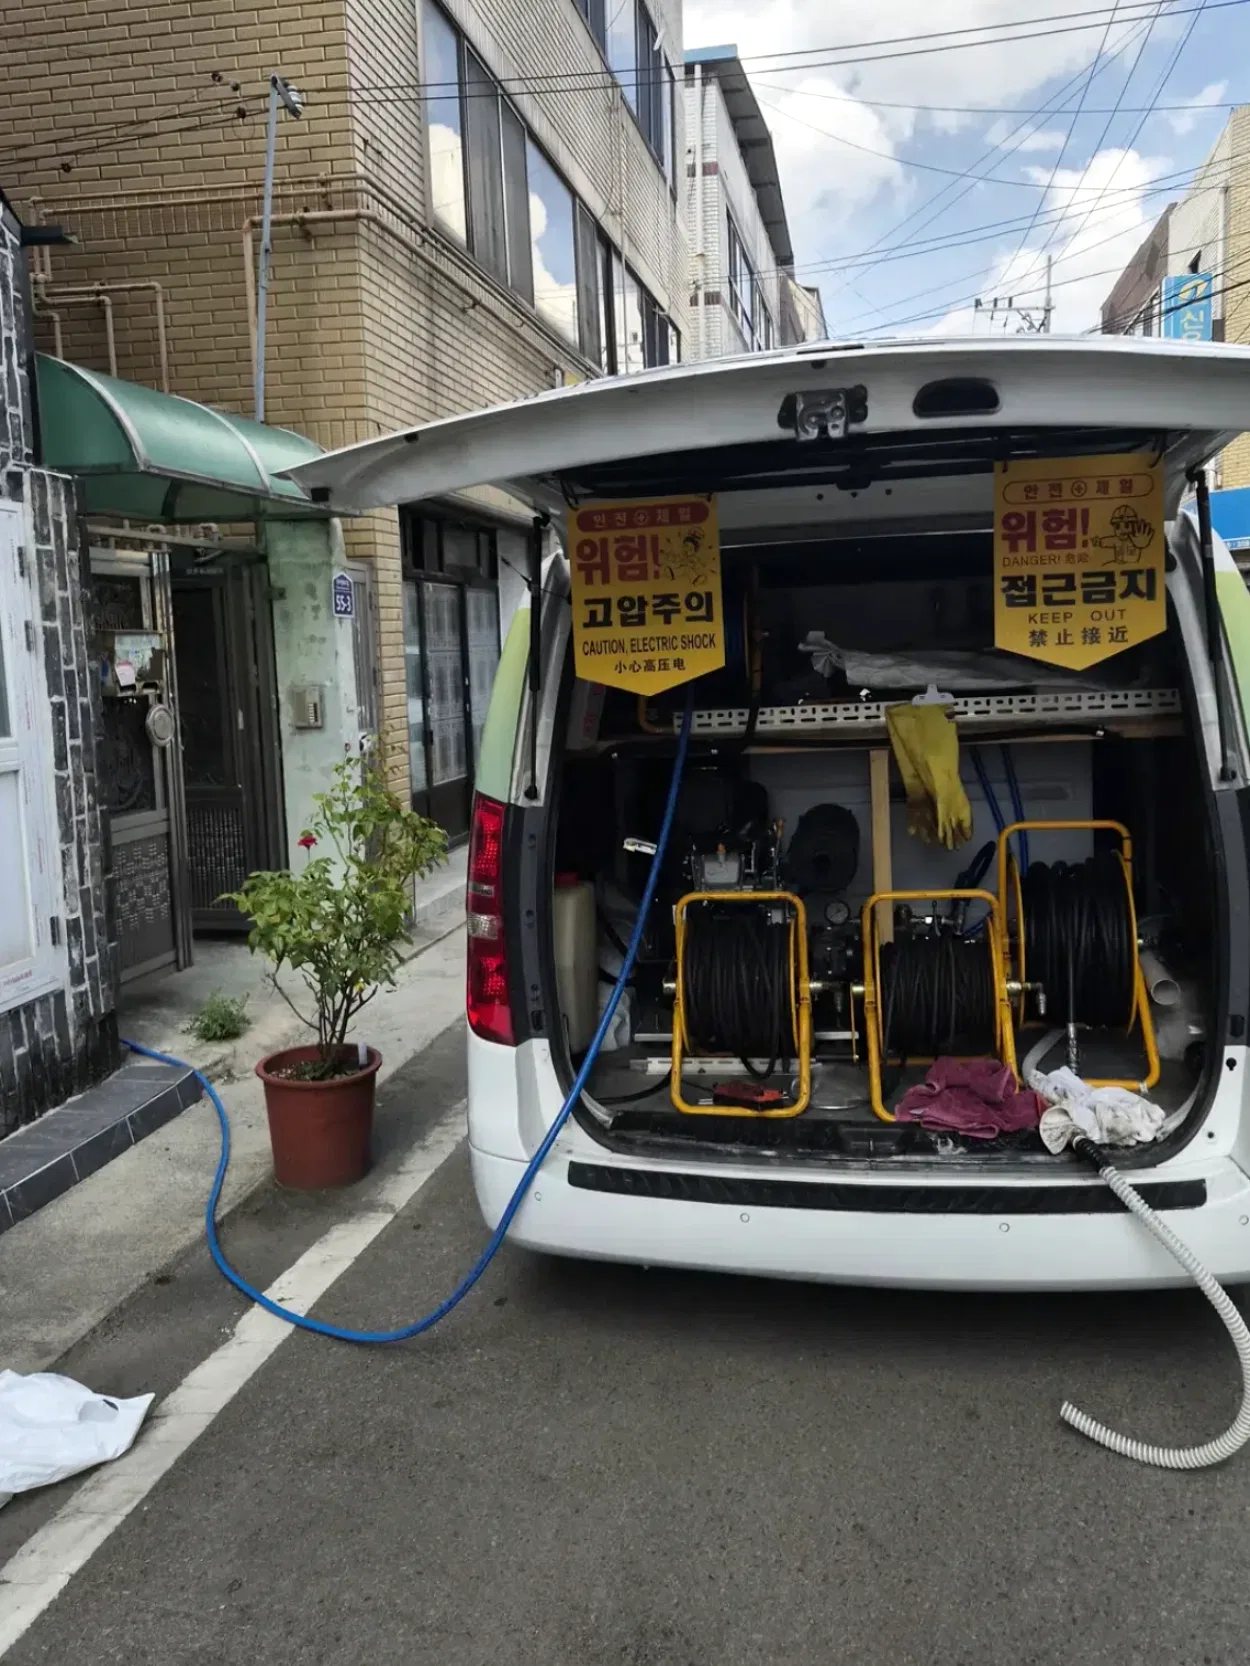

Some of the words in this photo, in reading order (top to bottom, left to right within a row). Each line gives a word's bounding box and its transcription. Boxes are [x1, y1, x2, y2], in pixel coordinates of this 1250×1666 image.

[1001, 508, 1090, 553] 위험!
[576, 535, 660, 586] 위험!
[1002, 555, 1061, 567] DANGER!
[1001, 568, 1157, 608] 접근금지
[582, 591, 714, 629] 고압주의
[1028, 612, 1073, 624] KEEP
[1090, 609, 1127, 622] OUT
[630, 636, 678, 654] ELECTRIC
[680, 633, 717, 651] SHOCK
[1028, 626, 1129, 648] 禁止接近
[614, 657, 687, 675] 小心高压电
